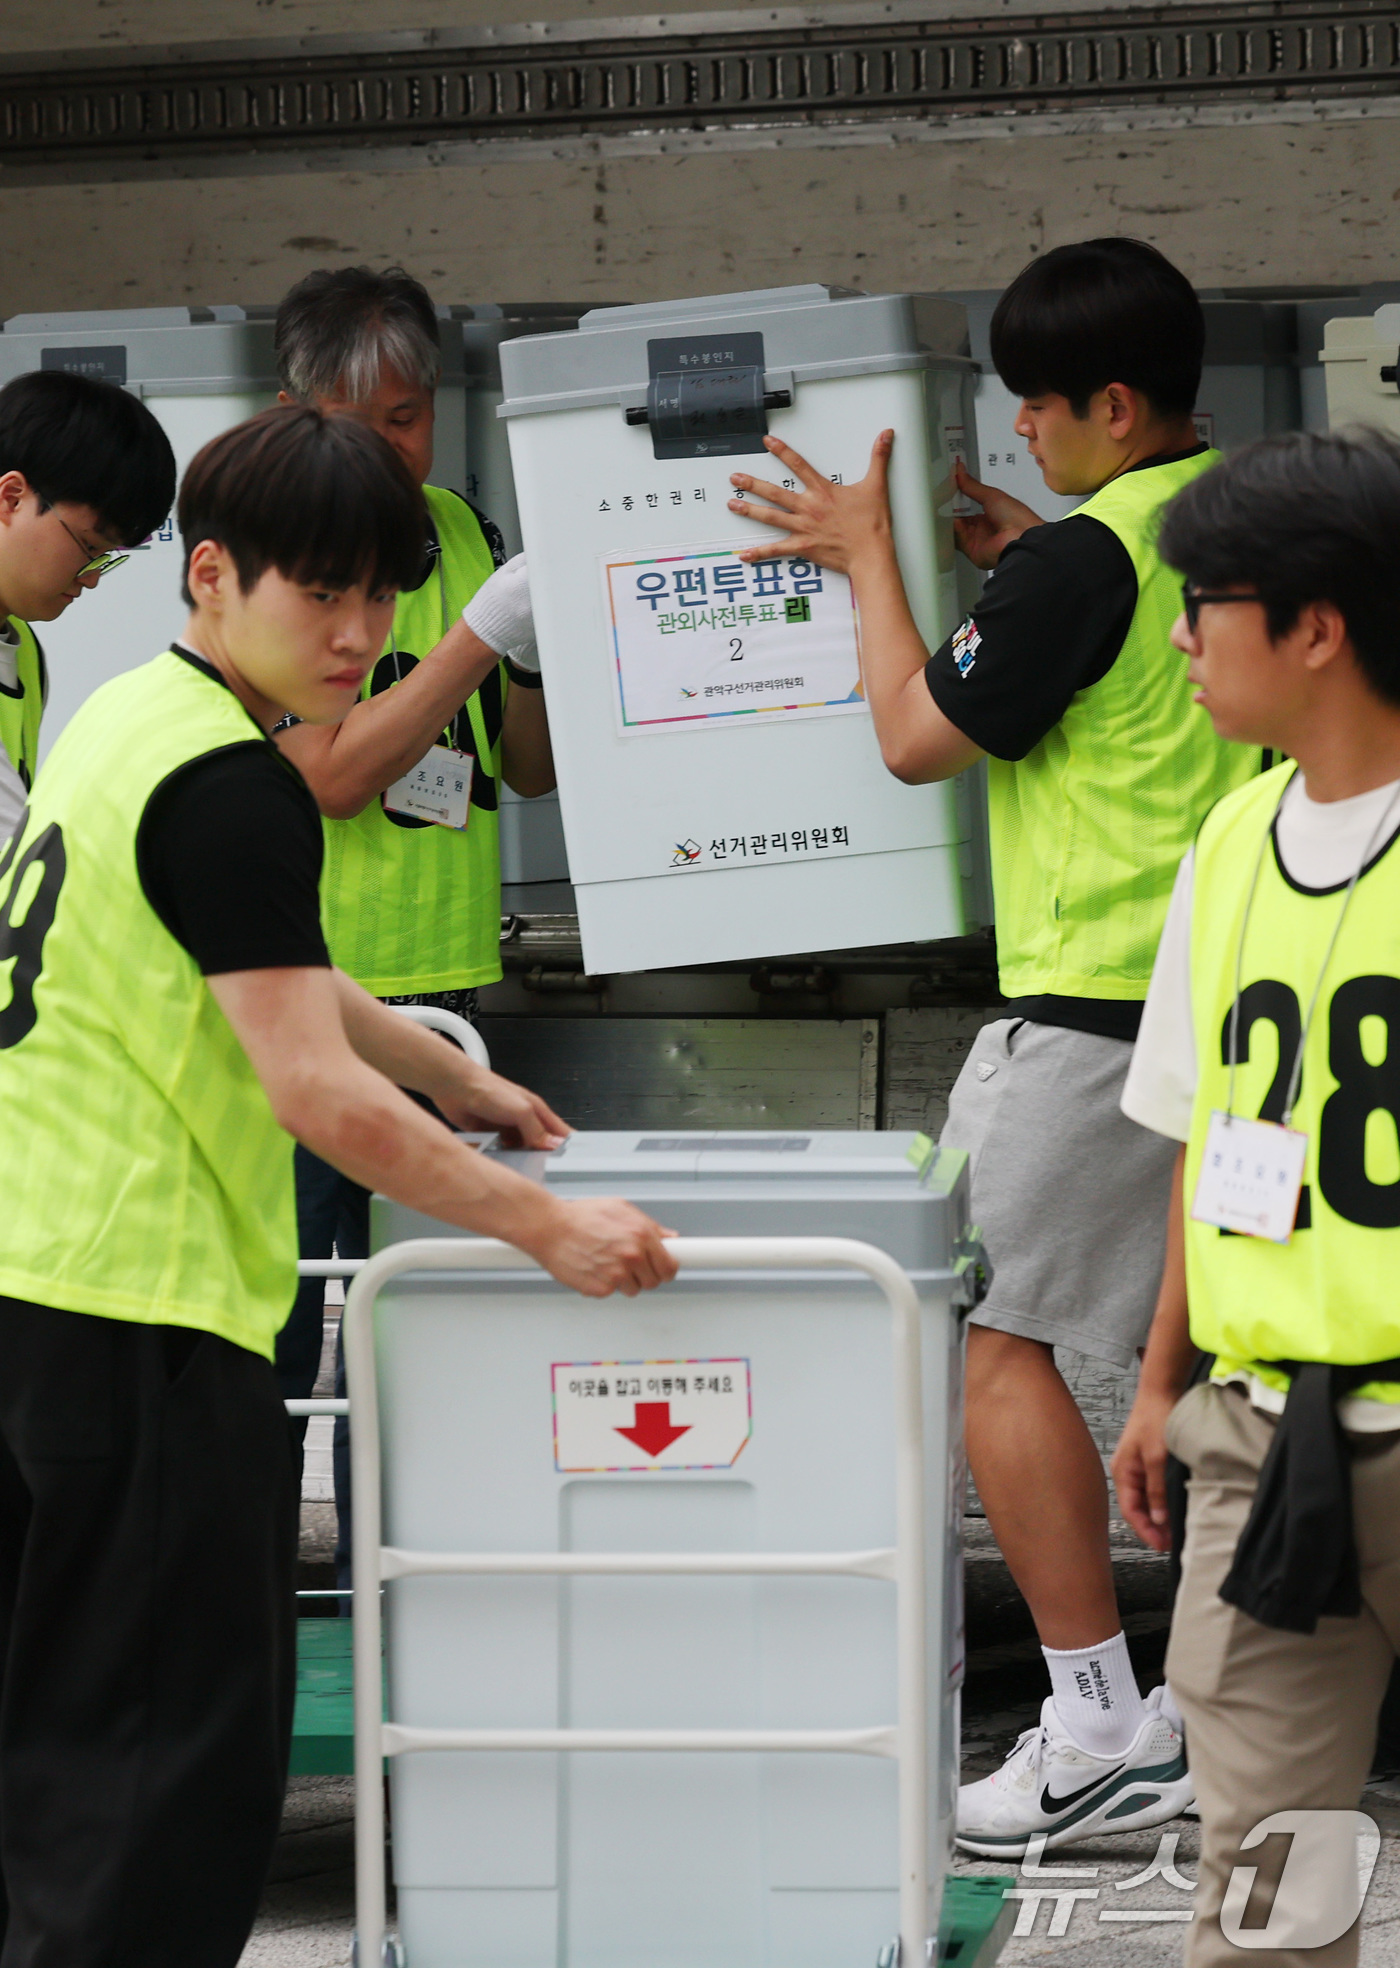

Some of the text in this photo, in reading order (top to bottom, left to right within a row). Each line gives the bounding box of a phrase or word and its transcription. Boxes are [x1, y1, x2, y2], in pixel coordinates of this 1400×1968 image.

[679, 352, 734, 365] 특수봉인지
[598, 488, 707, 512] 소중한권리
[636, 557, 824, 611] 우편투표함
[729, 637, 744, 662] 2
[703, 676, 804, 697] 관악구선거관리위원회
[403, 770, 464, 793] 조요원
[709, 825, 850, 860] 선거관리위원회
[1219, 975, 1400, 1237] 28
[569, 1376, 733, 1398] 이곳을 잡고 이동해 주세요
[1073, 1671, 1095, 1700] ADLV
